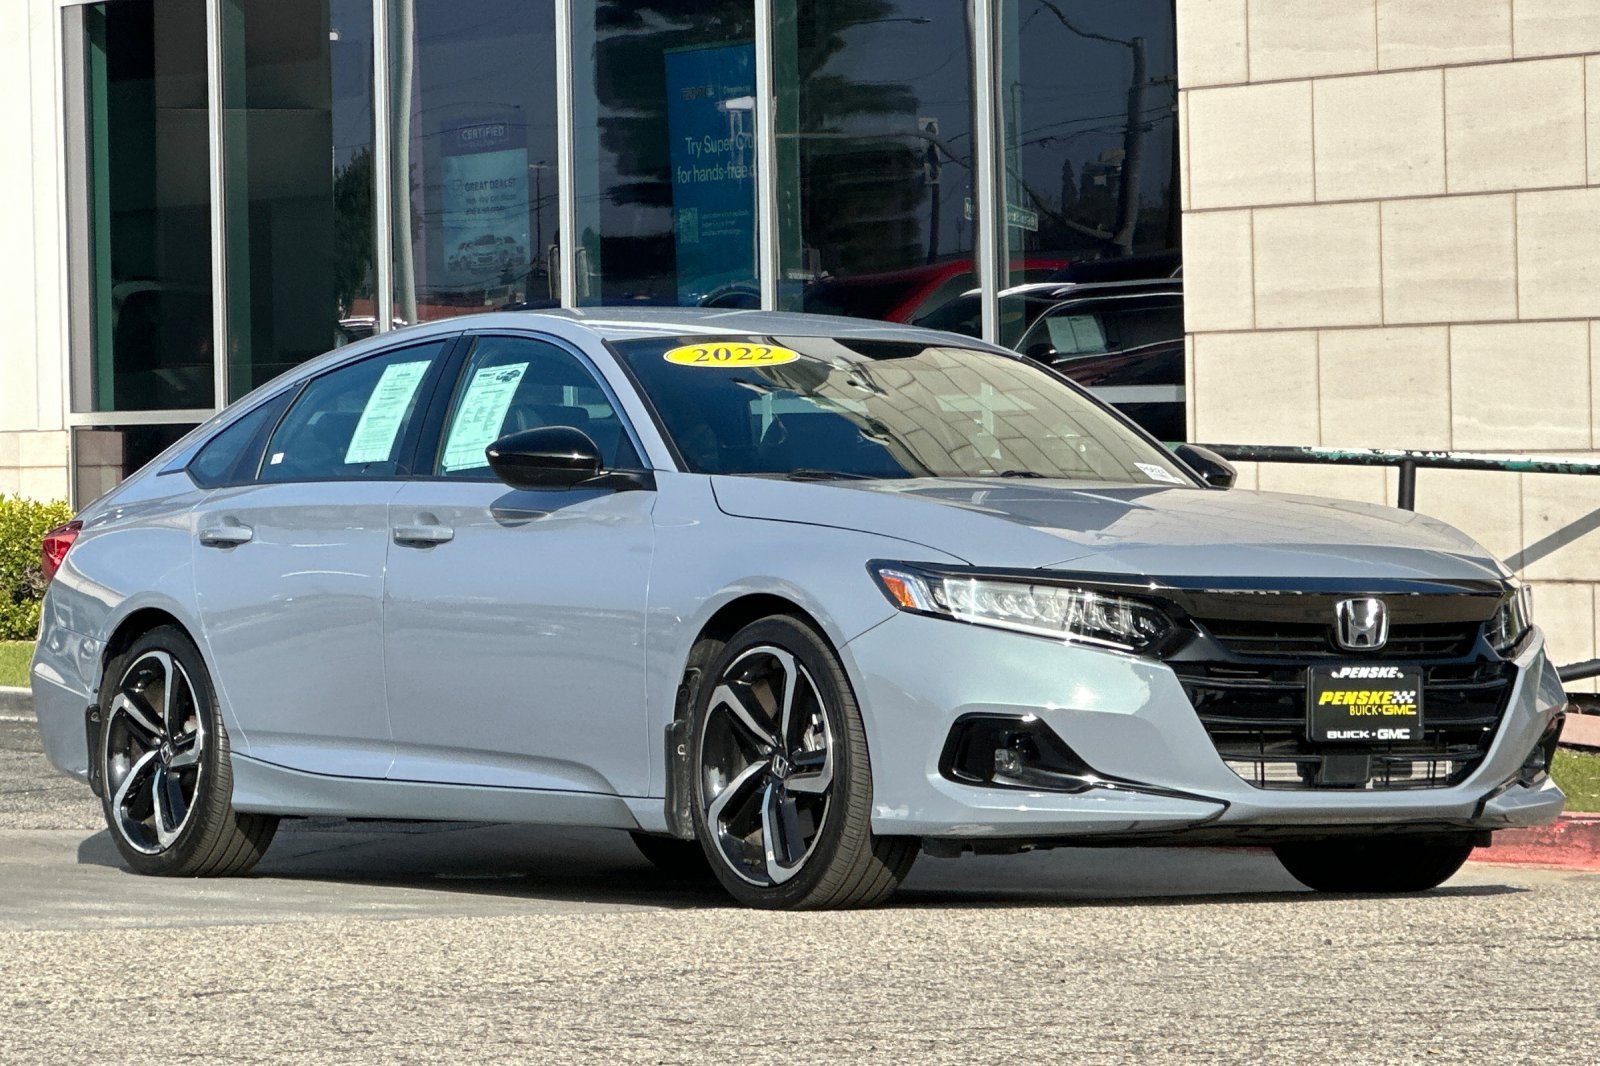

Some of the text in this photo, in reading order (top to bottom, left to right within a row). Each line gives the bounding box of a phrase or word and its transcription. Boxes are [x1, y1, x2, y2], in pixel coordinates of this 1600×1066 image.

[462, 126, 504, 140] CERTIFIED
[685, 137, 702, 158] Try
[703, 134, 734, 156] Super
[677, 166, 691, 184] for
[693, 160, 748, 183] hands-free
[464, 180, 488, 192] GREAT
[692, 347, 774, 363] 2022
[1338, 666, 1399, 679] PENSKE
[1318, 690, 1394, 706] PENSKE
